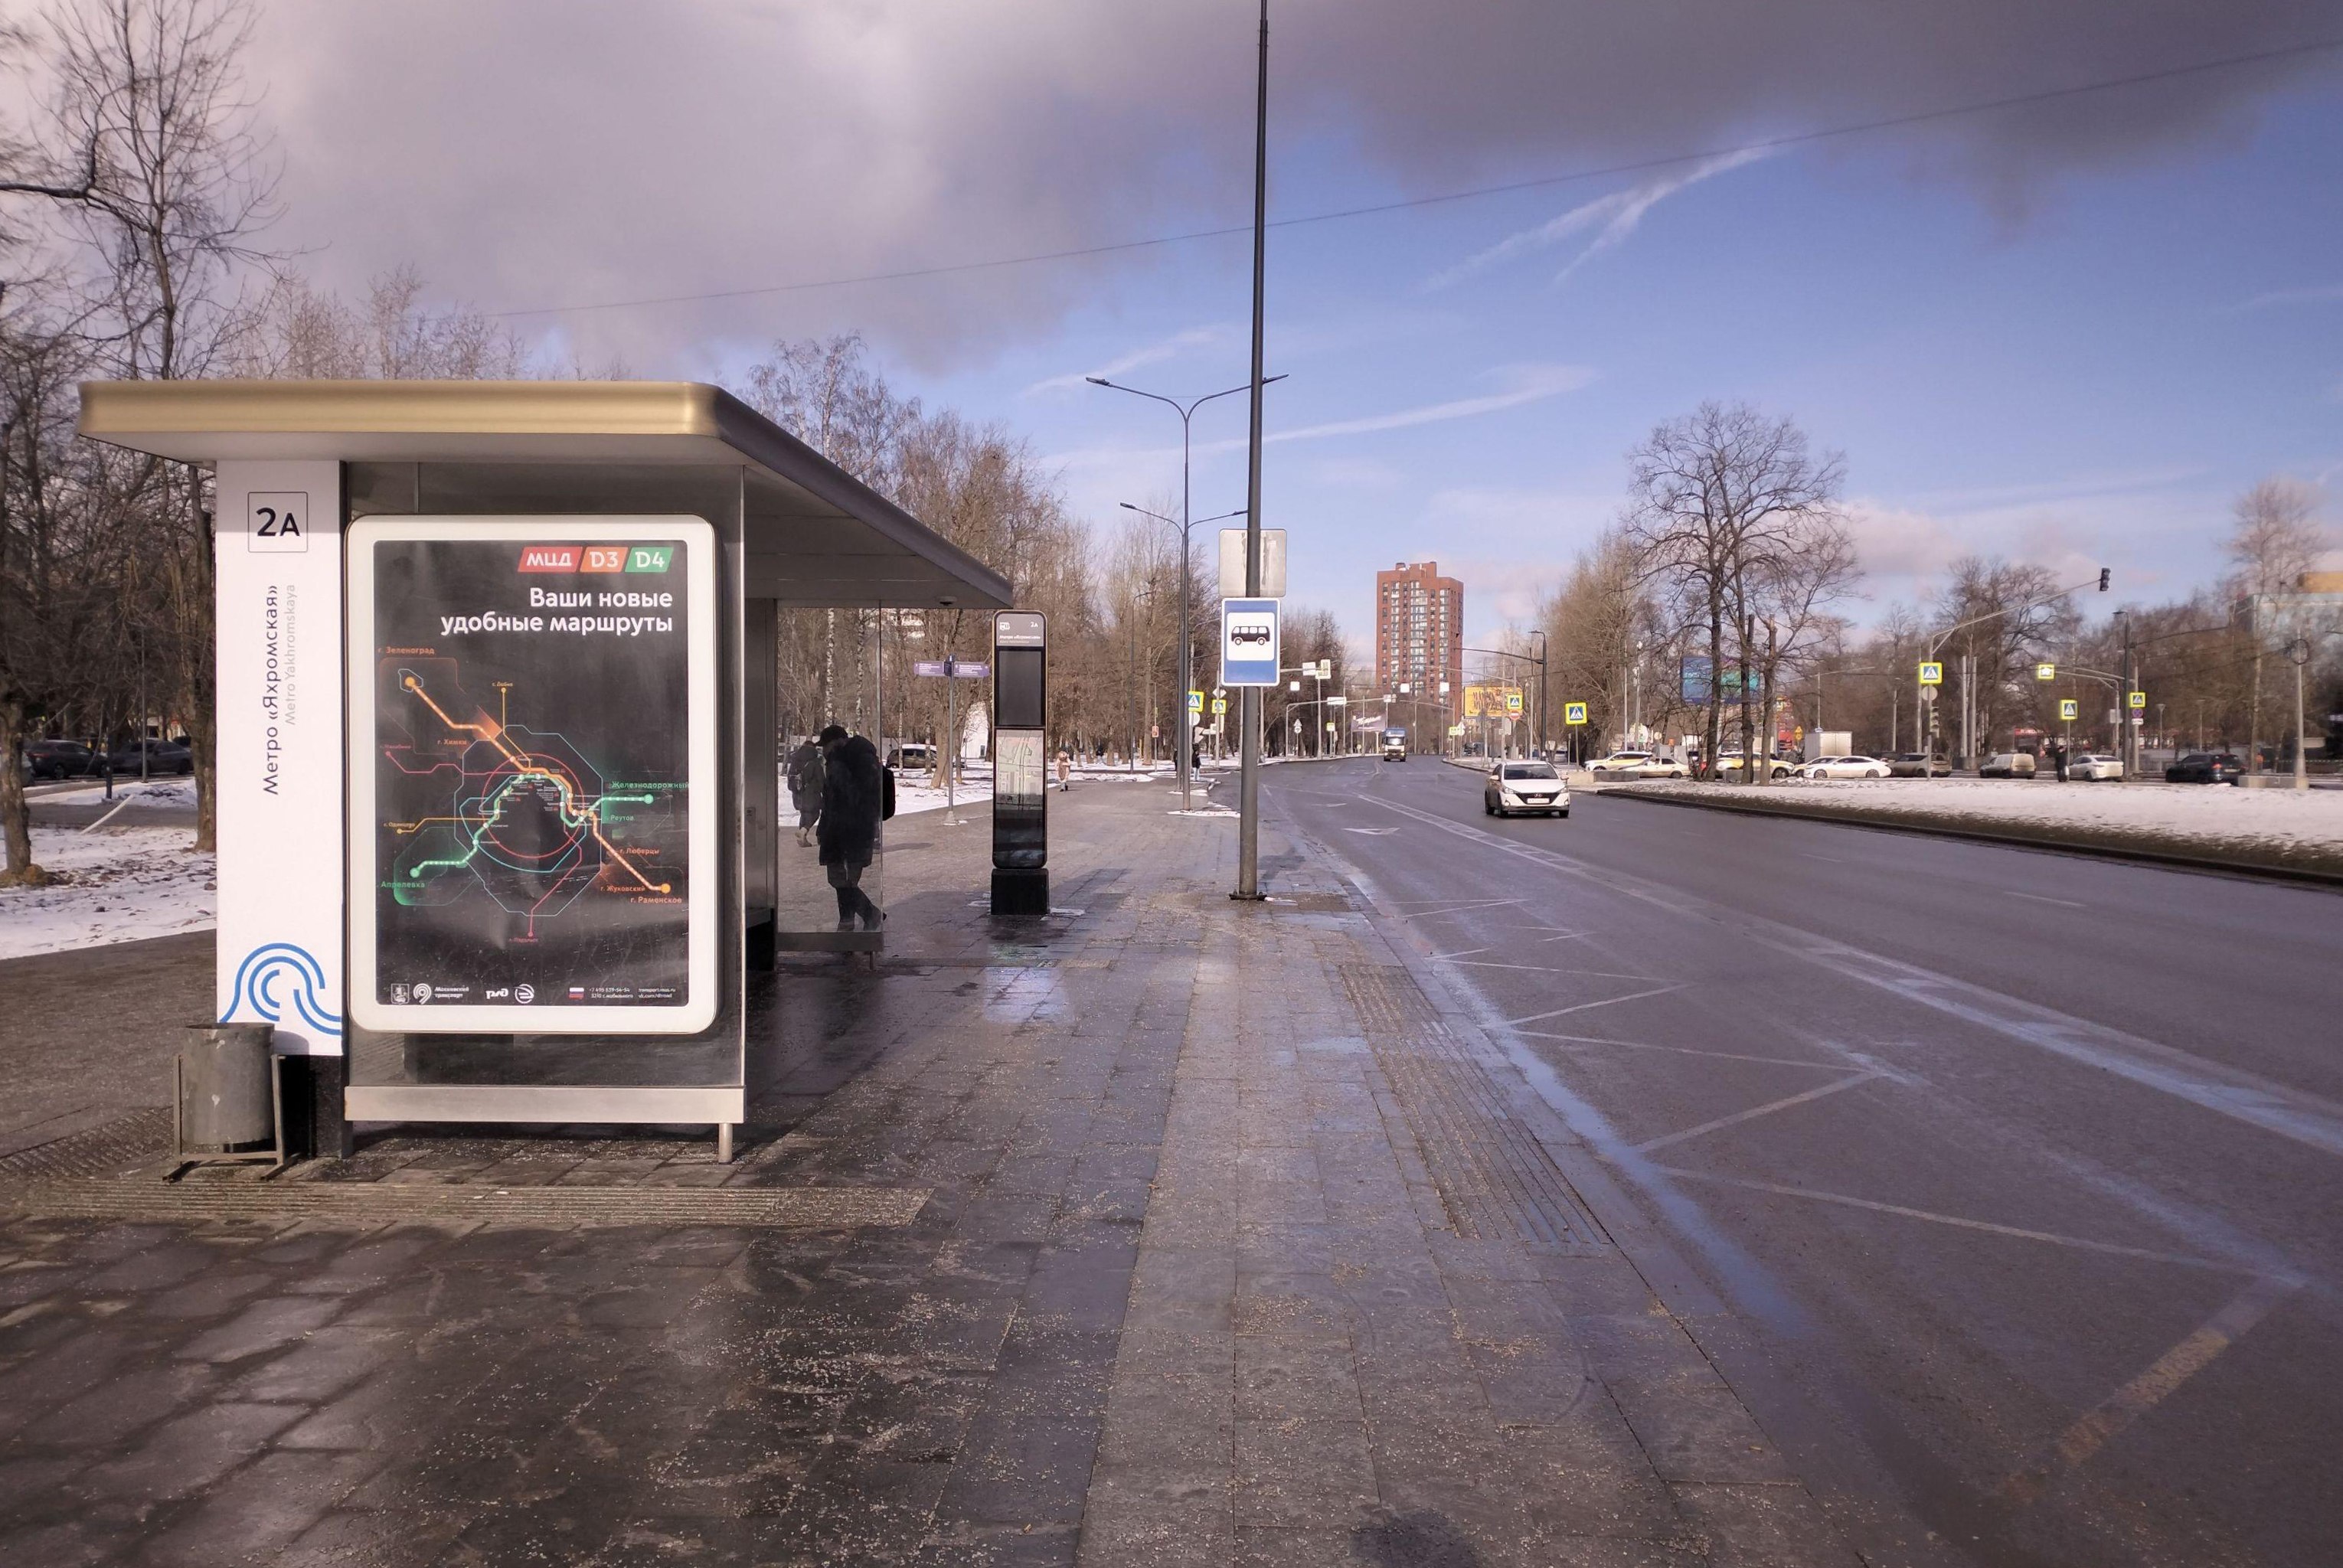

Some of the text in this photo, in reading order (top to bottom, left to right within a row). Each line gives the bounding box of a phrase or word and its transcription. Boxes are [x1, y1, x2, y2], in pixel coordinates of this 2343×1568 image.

[256, 507, 300, 537] 2А
[526, 550, 665, 568] МЦД D3 D4
[529, 586, 673, 608] Ваши новые
[440, 611, 673, 636] удобные маршруты
[285, 584, 298, 725] Metro Yakhromskaya
[385, 645, 436, 655] Зеленоград
[263, 585, 282, 795] Метро «Яхромская»
[381, 880, 426, 889] Апрелевка
